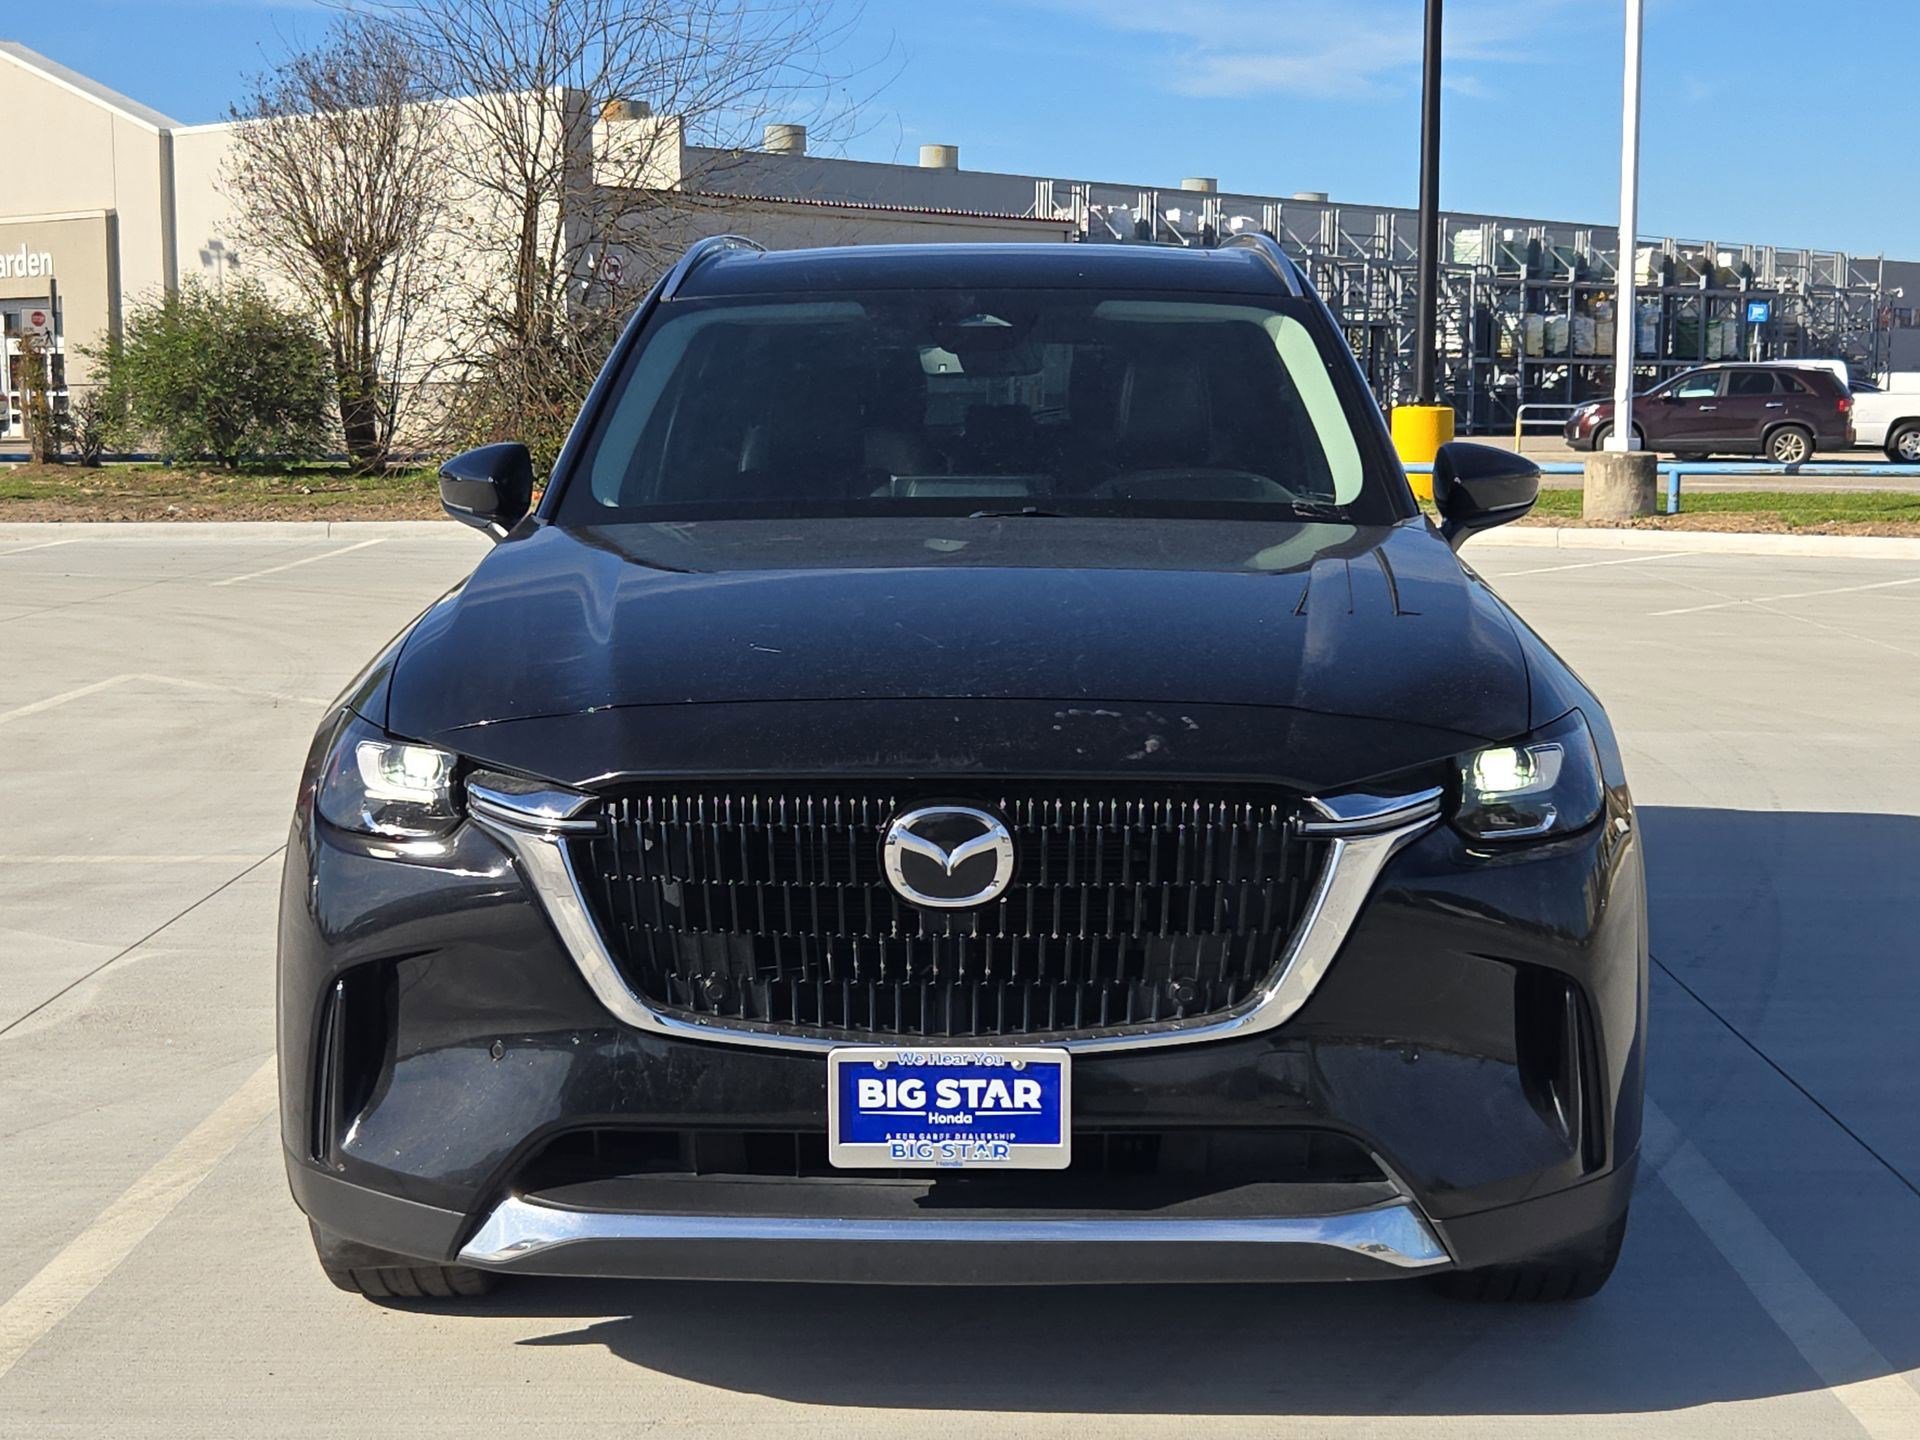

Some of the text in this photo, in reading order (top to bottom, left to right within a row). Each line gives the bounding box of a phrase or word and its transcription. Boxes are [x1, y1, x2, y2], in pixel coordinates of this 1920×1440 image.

[896, 1051, 1005, 1066] We Hear You
[858, 1079, 1042, 1108] BIG STAR
[928, 1112, 973, 1125] Honda
[954, 1133, 1017, 1141] DEALERSHIP
[891, 1142, 1011, 1159] BIG STAR
